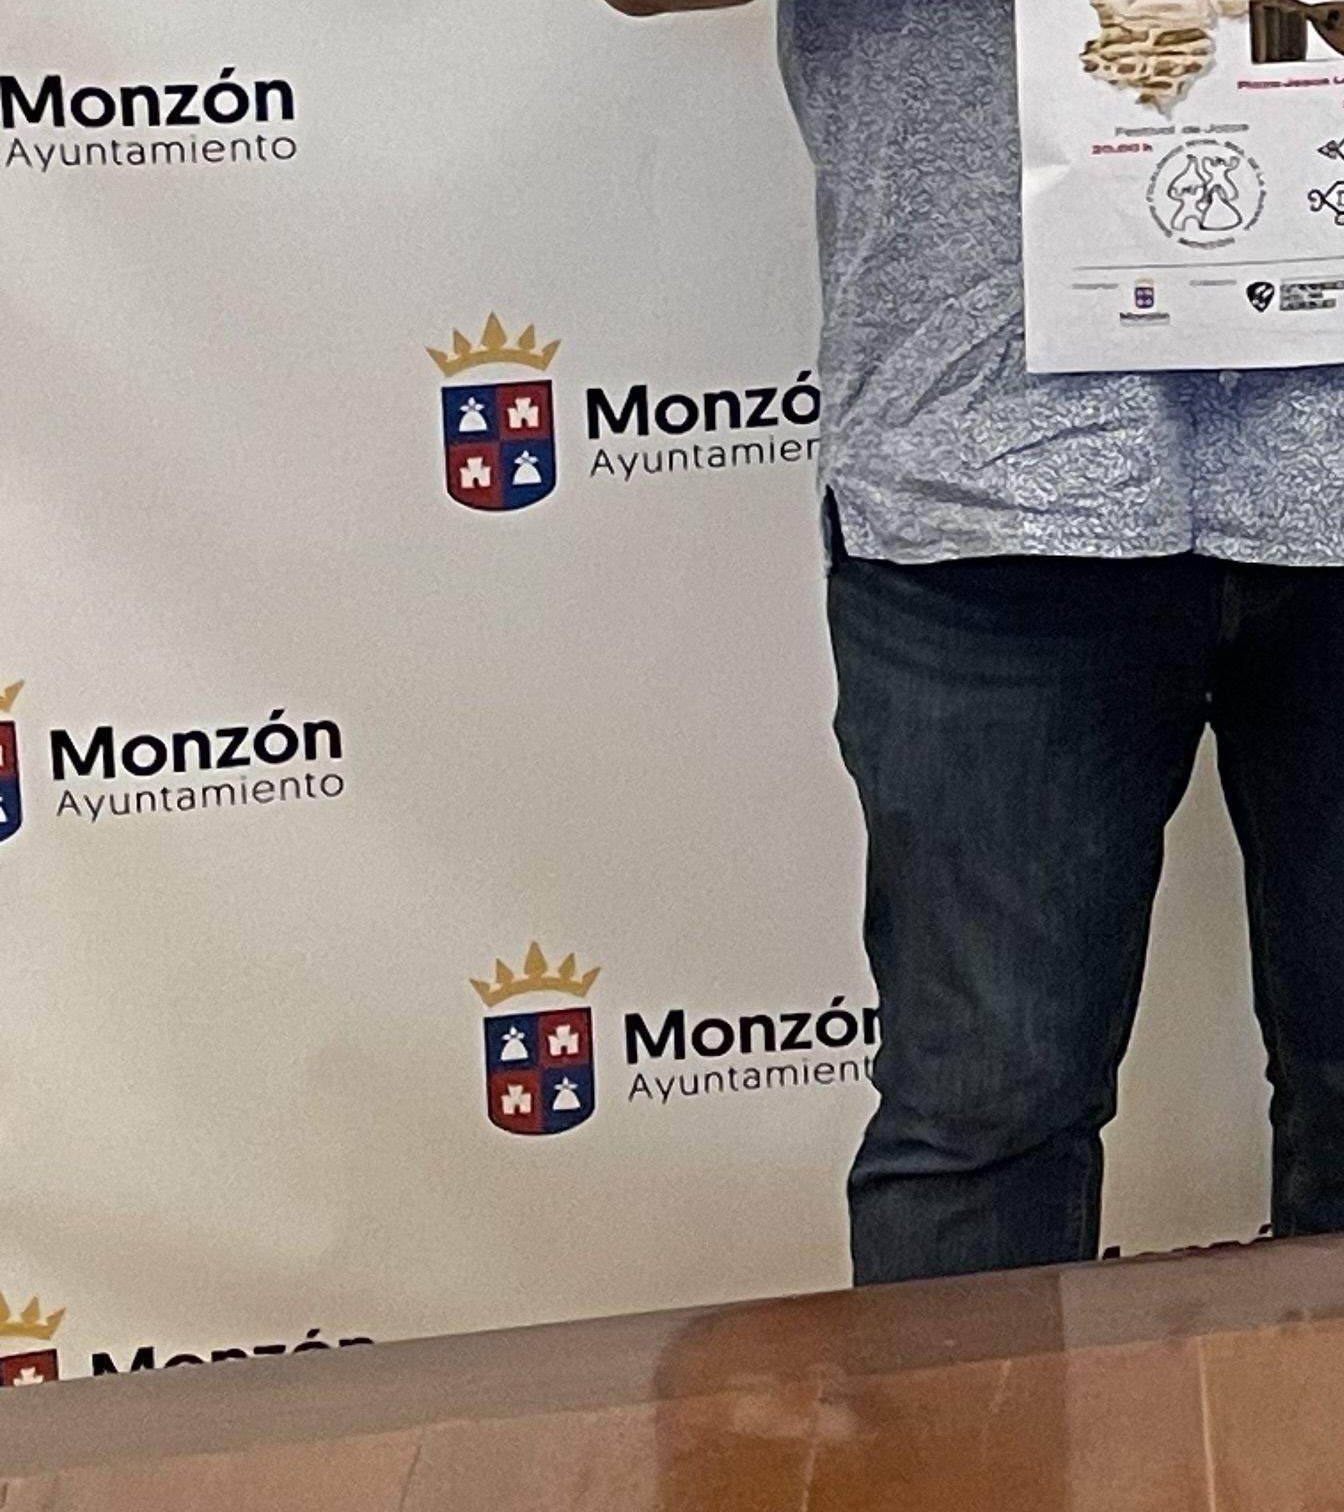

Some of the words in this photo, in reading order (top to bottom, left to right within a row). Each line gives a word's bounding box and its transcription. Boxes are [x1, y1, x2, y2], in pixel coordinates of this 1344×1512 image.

[0, 67, 294, 129] Monzón
[5, 134, 297, 173] Ayuntamiento
[586, 370, 820, 440] Monzó
[50, 708, 342, 780] Monzón
[56, 773, 344, 823] Ayuntamiento
[628, 1055, 873, 1105] Ayuntamient
